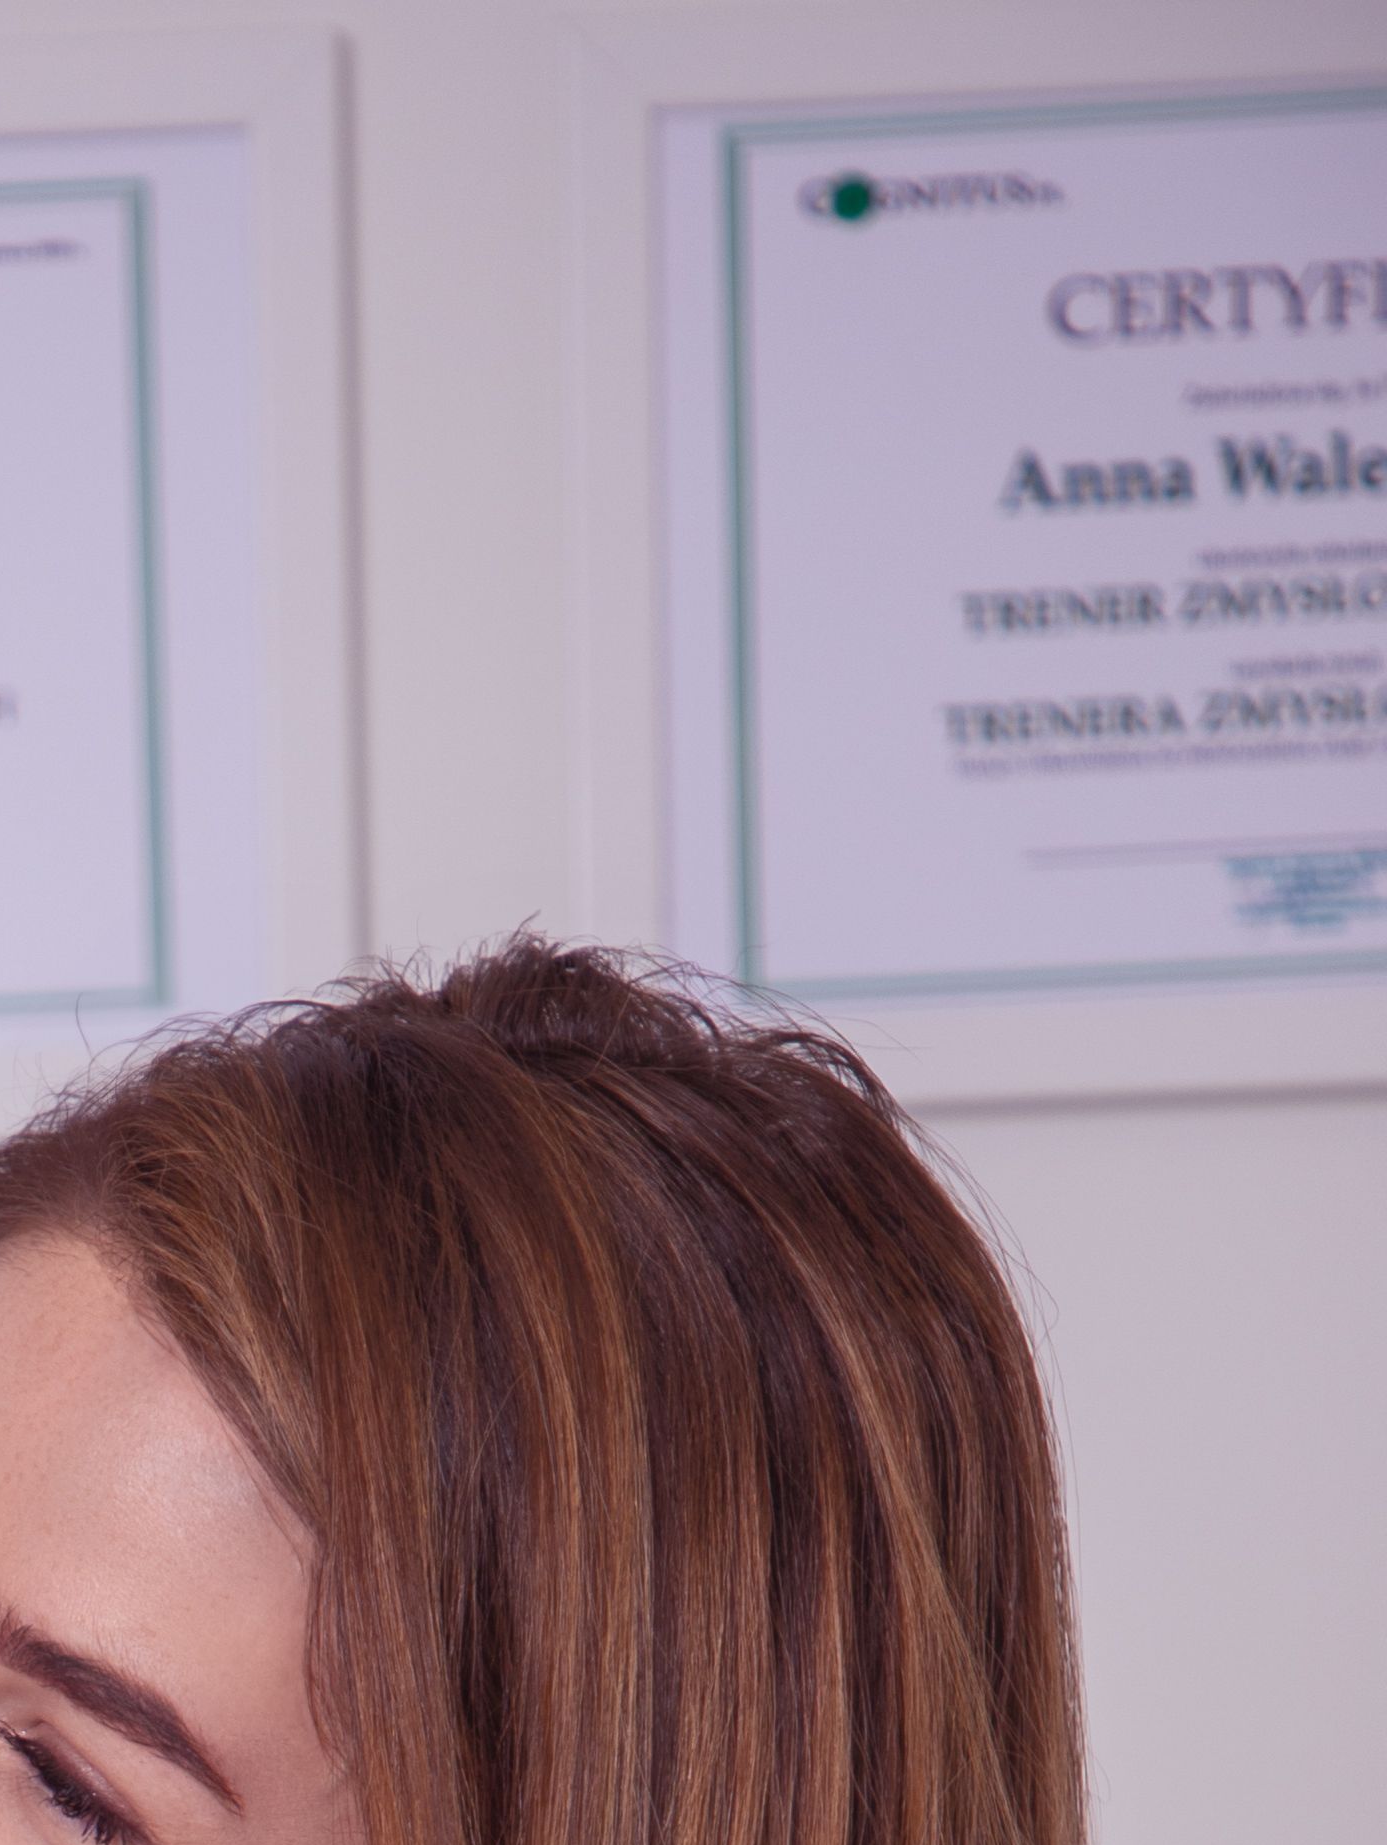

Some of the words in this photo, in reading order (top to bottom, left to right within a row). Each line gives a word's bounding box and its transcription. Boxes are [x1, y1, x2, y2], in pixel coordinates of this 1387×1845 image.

[1000, 446, 1195, 511] Anna
[957, 583, 1163, 632] TRENER
[941, 694, 1184, 746] TRENERA
